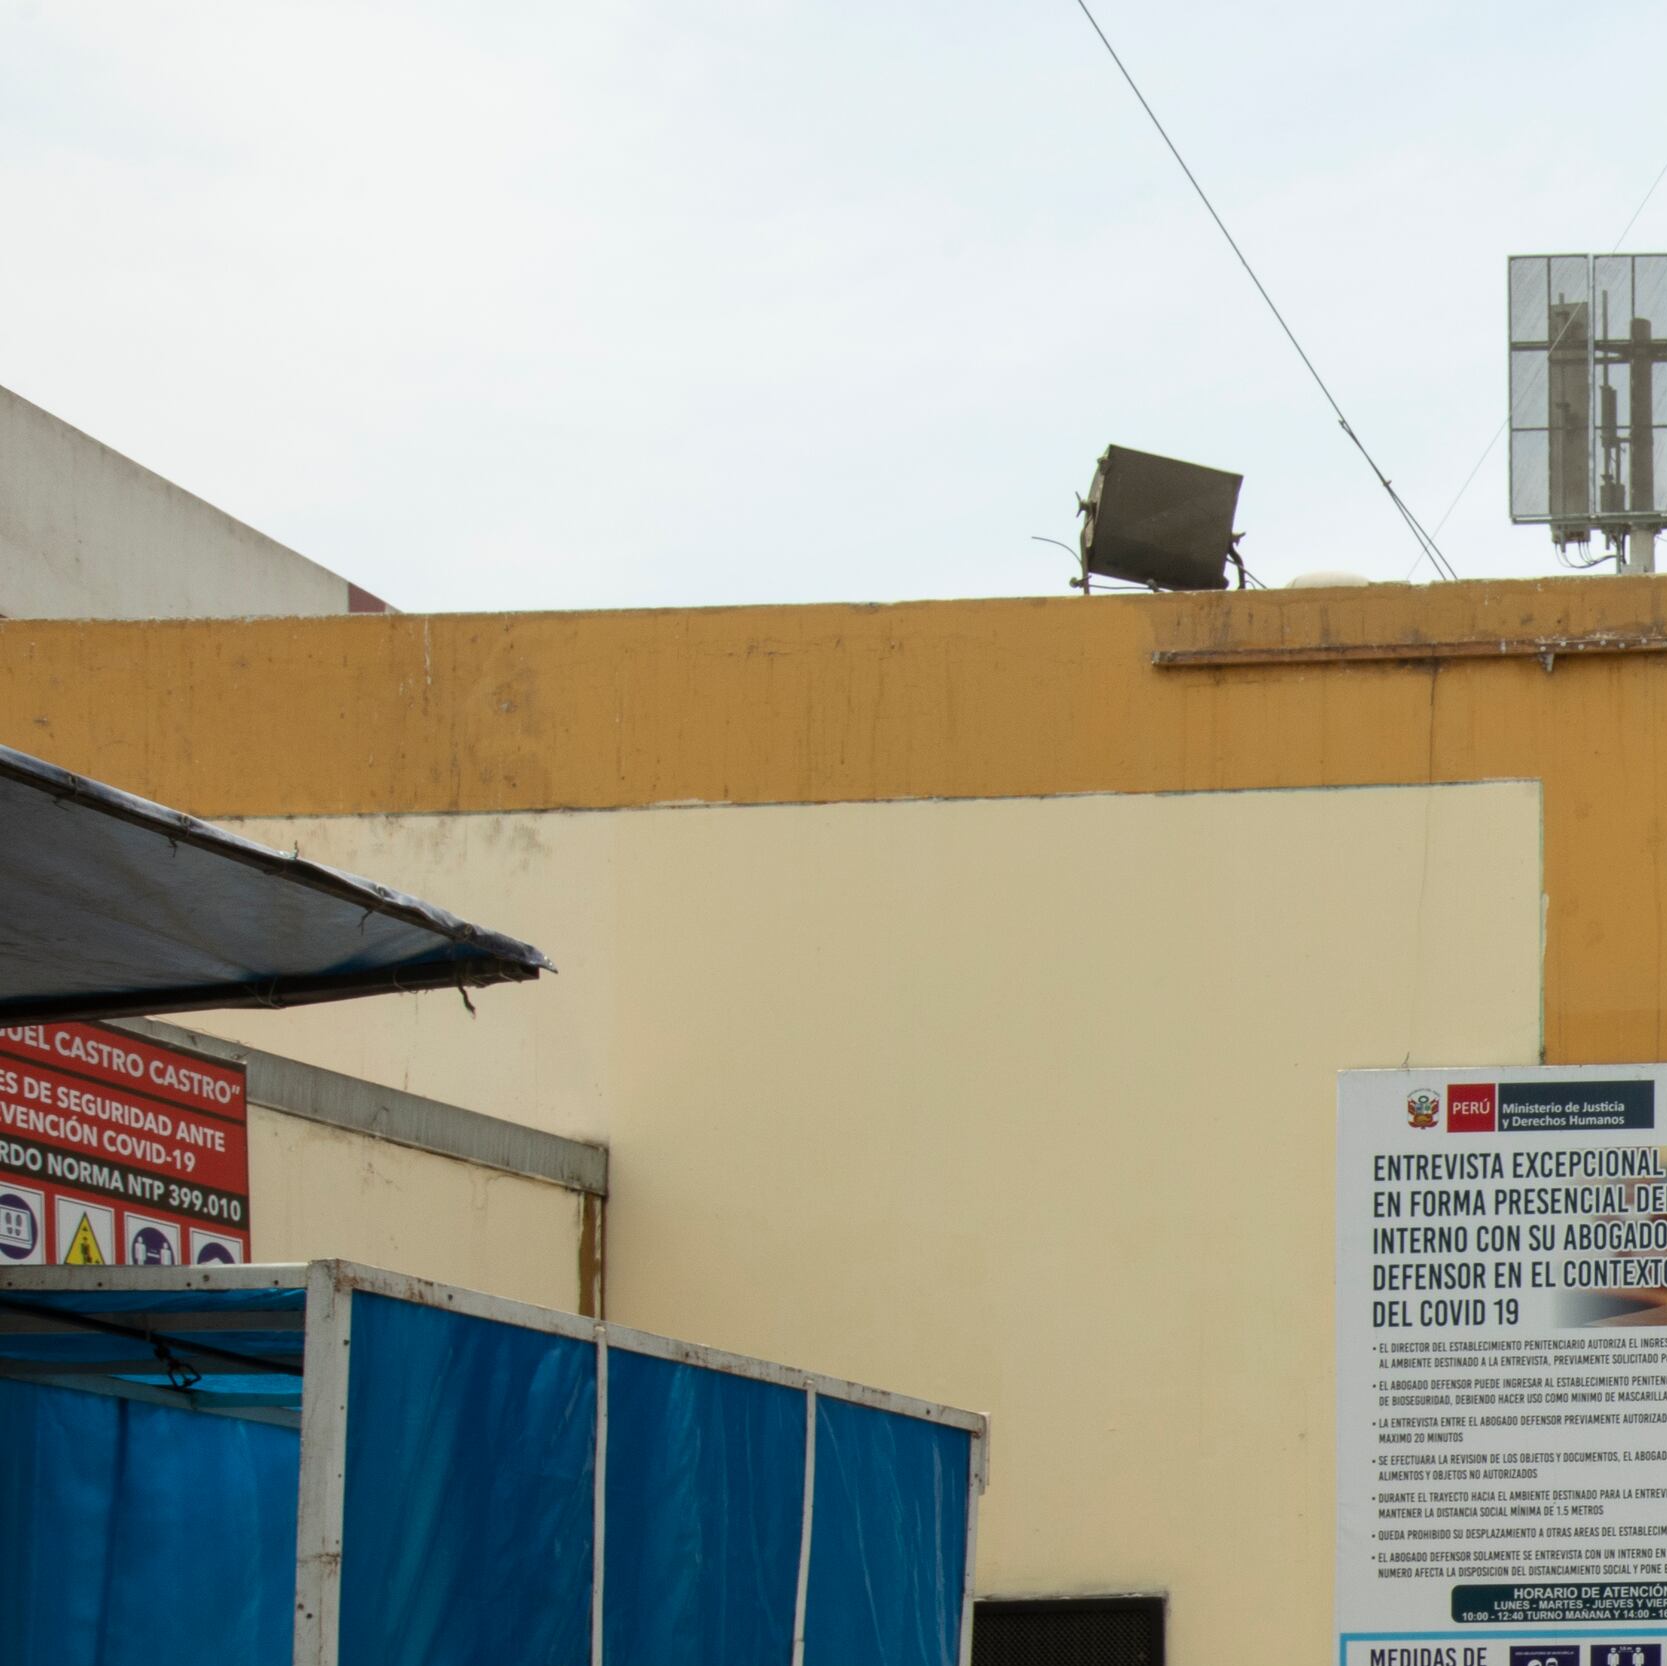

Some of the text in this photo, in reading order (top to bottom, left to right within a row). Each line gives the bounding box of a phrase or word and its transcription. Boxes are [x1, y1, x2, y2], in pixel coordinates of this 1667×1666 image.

[0, 1027, 50, 1050] UEL
[54, 1031, 144, 1077] CASTRO
[24, 1076, 52, 1104] DE
[57, 1086, 172, 1136] SEGURIDAD
[176, 1121, 225, 1152] ANTE
[1453, 1098, 1490, 1115] PERÚ
[1503, 1100, 1626, 1115] Ministerio de Justicia
[1503, 1113, 1626, 1130] y Derechos Humanos
[0, 1101, 195, 1172] VENCIÓN COVID-19
[1374, 1147, 1665, 1184] ENTREVISTA EXCEPCIONAL
[47, 1153, 124, 1192] NORMA
[128, 1174, 165, 1201] NTP
[169, 1184, 241, 1221] 399.010
[1374, 1190, 1400, 1219] EN
[1411, 1188, 1485, 1219] FORMA
[1495, 1186, 1629, 1216] PRESENCIAL
[1374, 1225, 1467, 1256] INTERNO
[1477, 1224, 1520, 1254] CON
[1529, 1223, 1554, 1253] SU
[1374, 1260, 1485, 1292] DEFENSOR
[1495, 1259, 1521, 1291] EN
[1532, 1259, 1555, 1290] EL
[1373, 1298, 1519, 1327] DEL COVID 19
[1378, 1530, 1405, 1541] QUEDA
[1407, 1529, 1451, 1540] PROHIBIDO
[1453, 1529, 1464, 1539] SU
[1466, 1528, 1537, 1539] DESPLAZAMIENTO
[1539, 1528, 1544, 1537] A
[1546, 1527, 1572, 1538] OTRAS
[1574, 1527, 1600, 1537] AREAS
[1602, 1526, 1616, 1537] DEL
[1494, 1600, 1530, 1611] LUNES
[1539, 1599, 1583, 1611] MARTES
[1592, 1598, 1634, 1610] JUEVES
[1636, 1598, 1644, 1609] Y
[1514, 1586, 1578, 1600] HORARIO
[1581, 1585, 1600, 1600] DE
[1462, 1611, 1488, 1623] 10:00
[1498, 1610, 1524, 1622] 12:40
[1526, 1610, 1563, 1622] TURNO
[1565, 1609, 1611, 1621] MAÑANA
[1613, 1609, 1620, 1621] Y
[1623, 1608, 1649, 1620] 14:00
